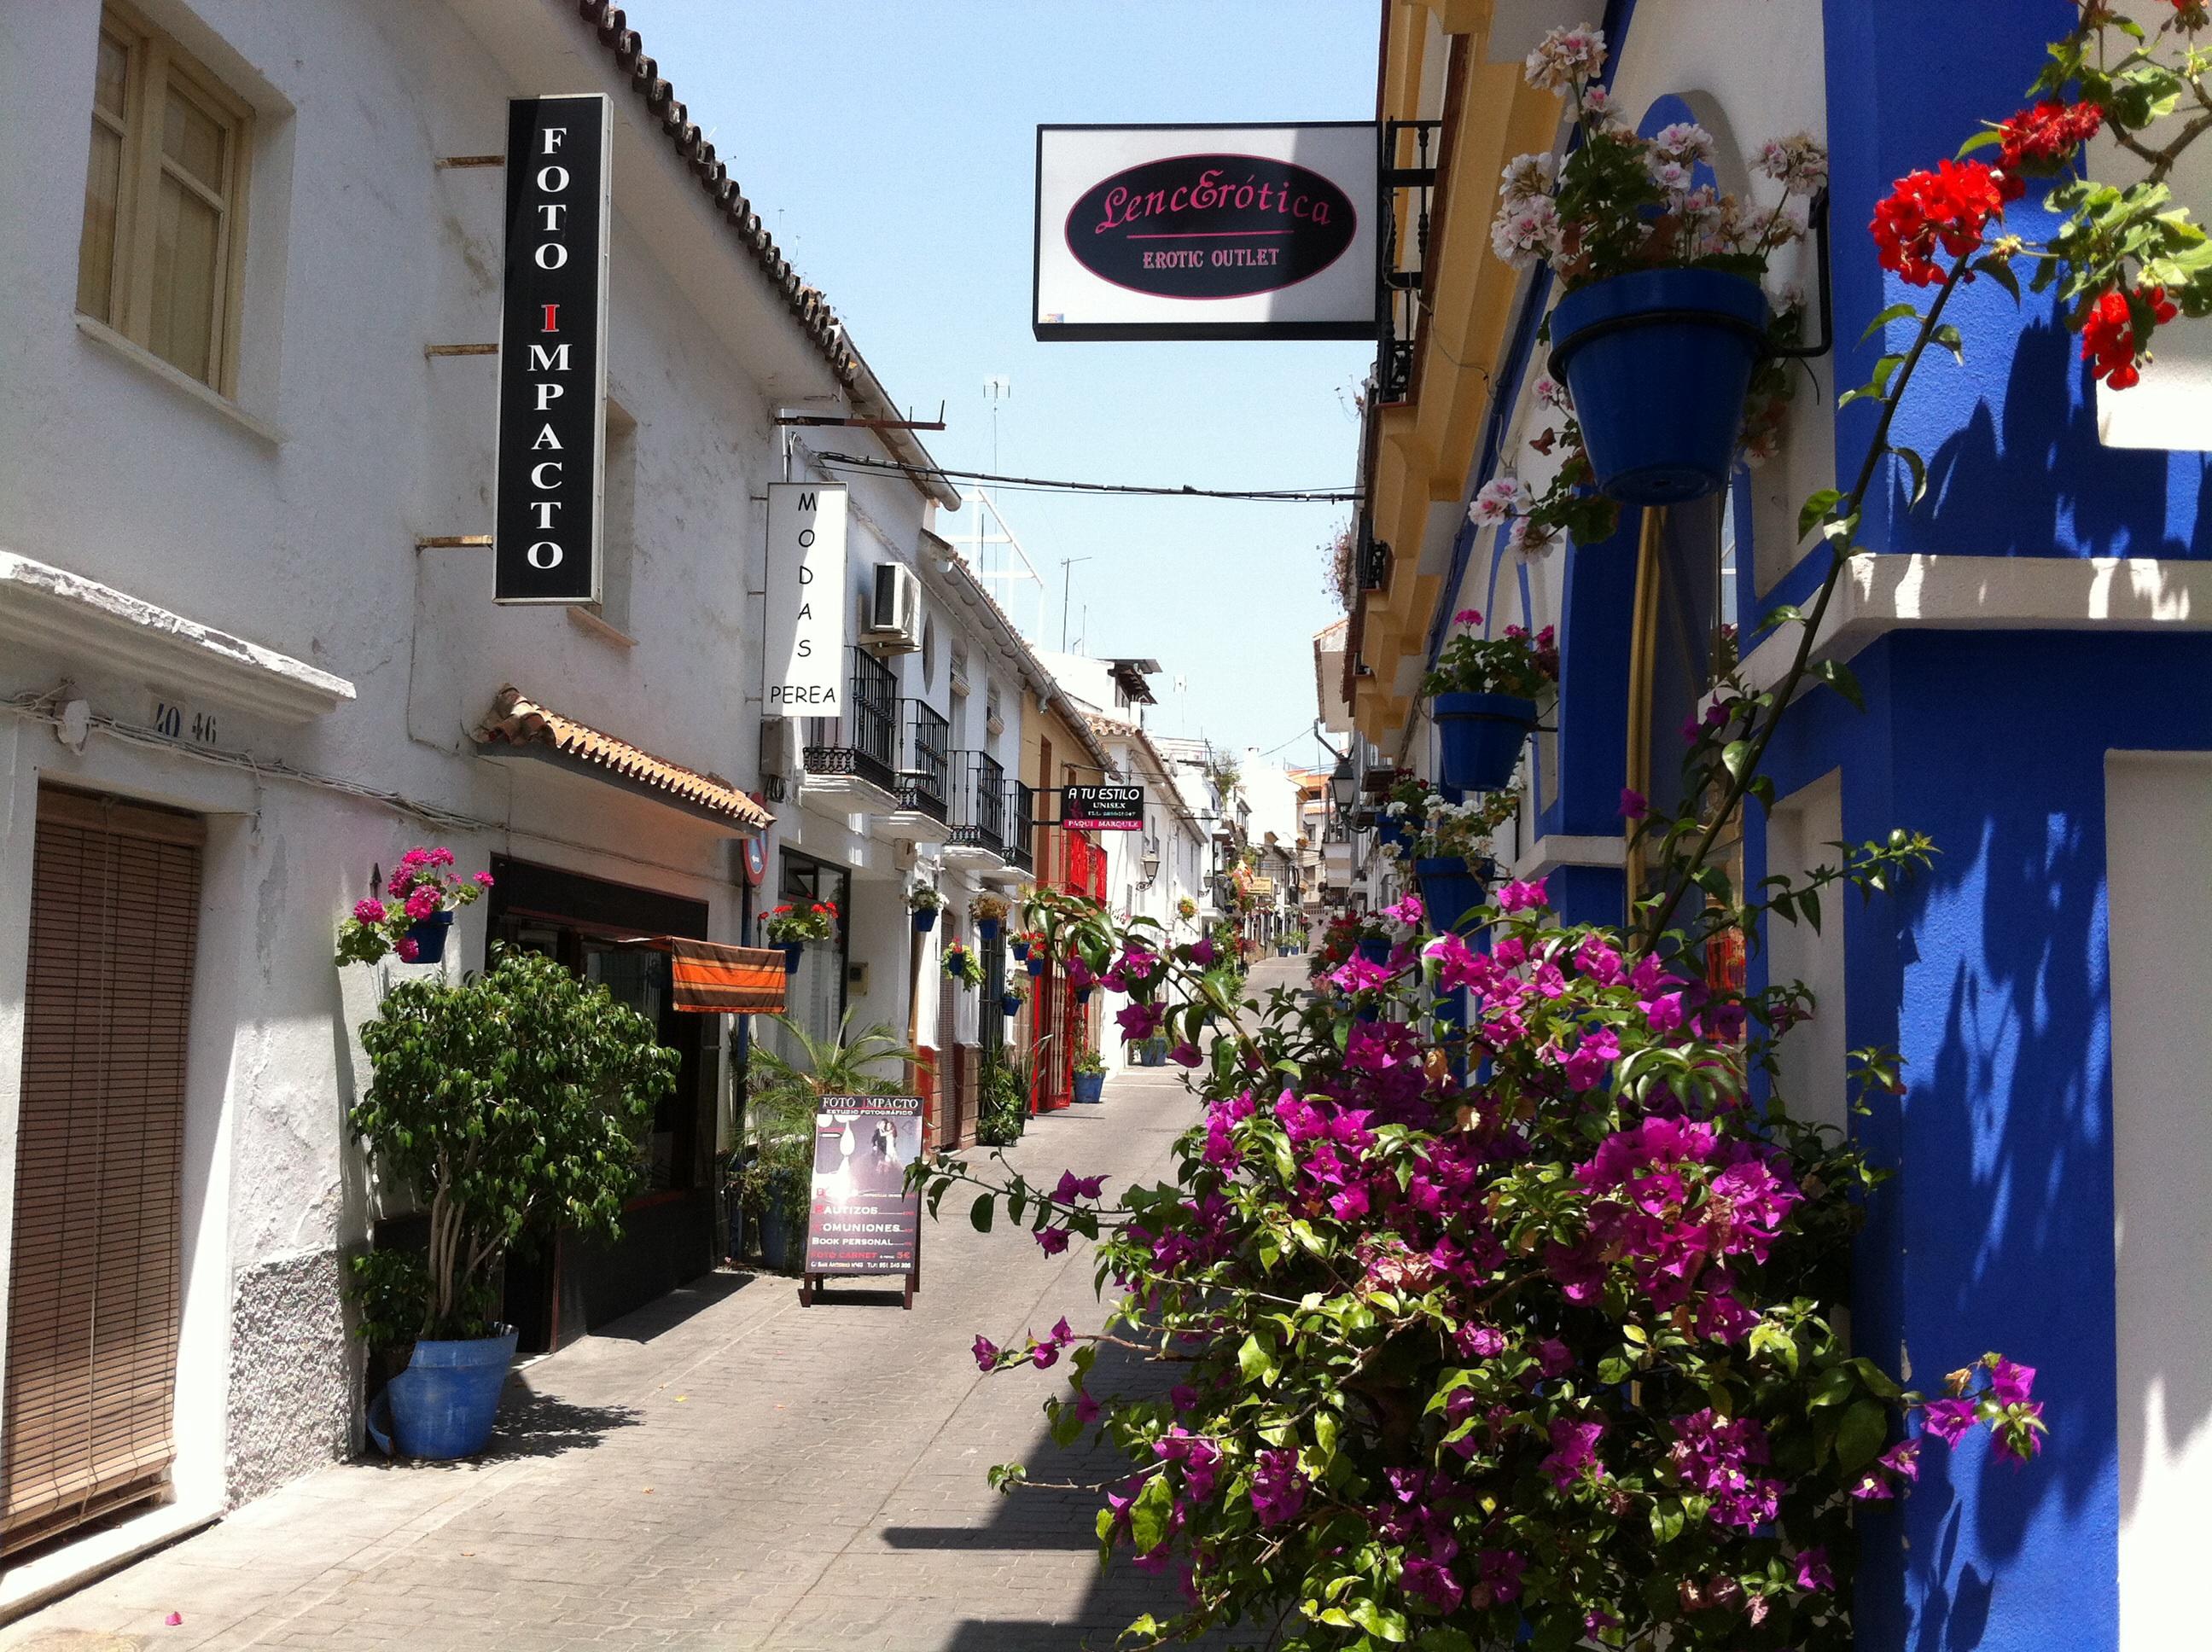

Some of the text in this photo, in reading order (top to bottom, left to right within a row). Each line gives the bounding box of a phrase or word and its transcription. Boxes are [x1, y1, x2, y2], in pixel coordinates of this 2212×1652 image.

[1095, 170, 1331, 234] LencErótica
[1143, 248, 1279, 269] EROTIC OUTLET
[527, 127, 573, 569] FOTO IMPACTO
[798, 492, 817, 657] MODAS
[771, 686, 835, 703] PEREA
[192, 713, 217, 743] 46
[1068, 788, 1140, 800] A TU ESTILO
[823, 1097, 919, 1108] FOTO IMPACTO
